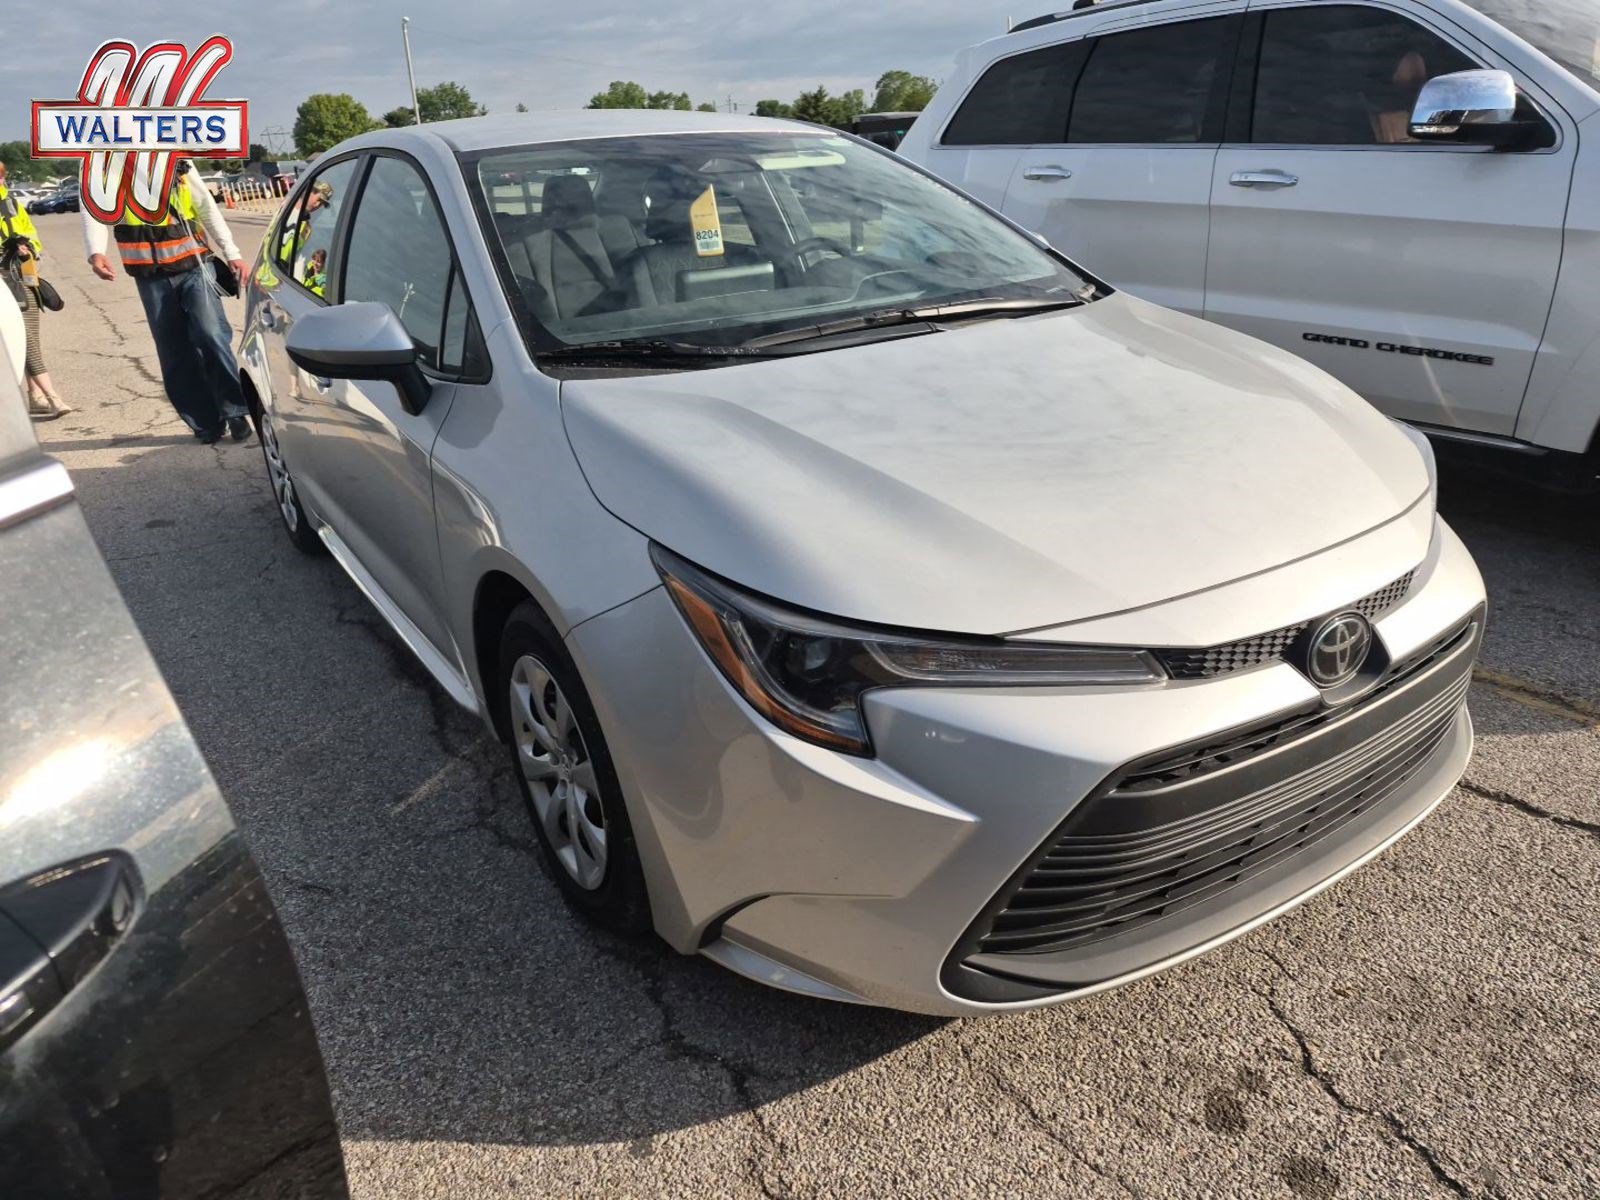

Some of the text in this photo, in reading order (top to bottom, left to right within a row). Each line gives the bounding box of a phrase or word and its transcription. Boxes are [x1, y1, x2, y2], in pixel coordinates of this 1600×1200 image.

[695, 229, 719, 240] 8204
[1302, 332, 1495, 366] GRAND CHEROKEE
